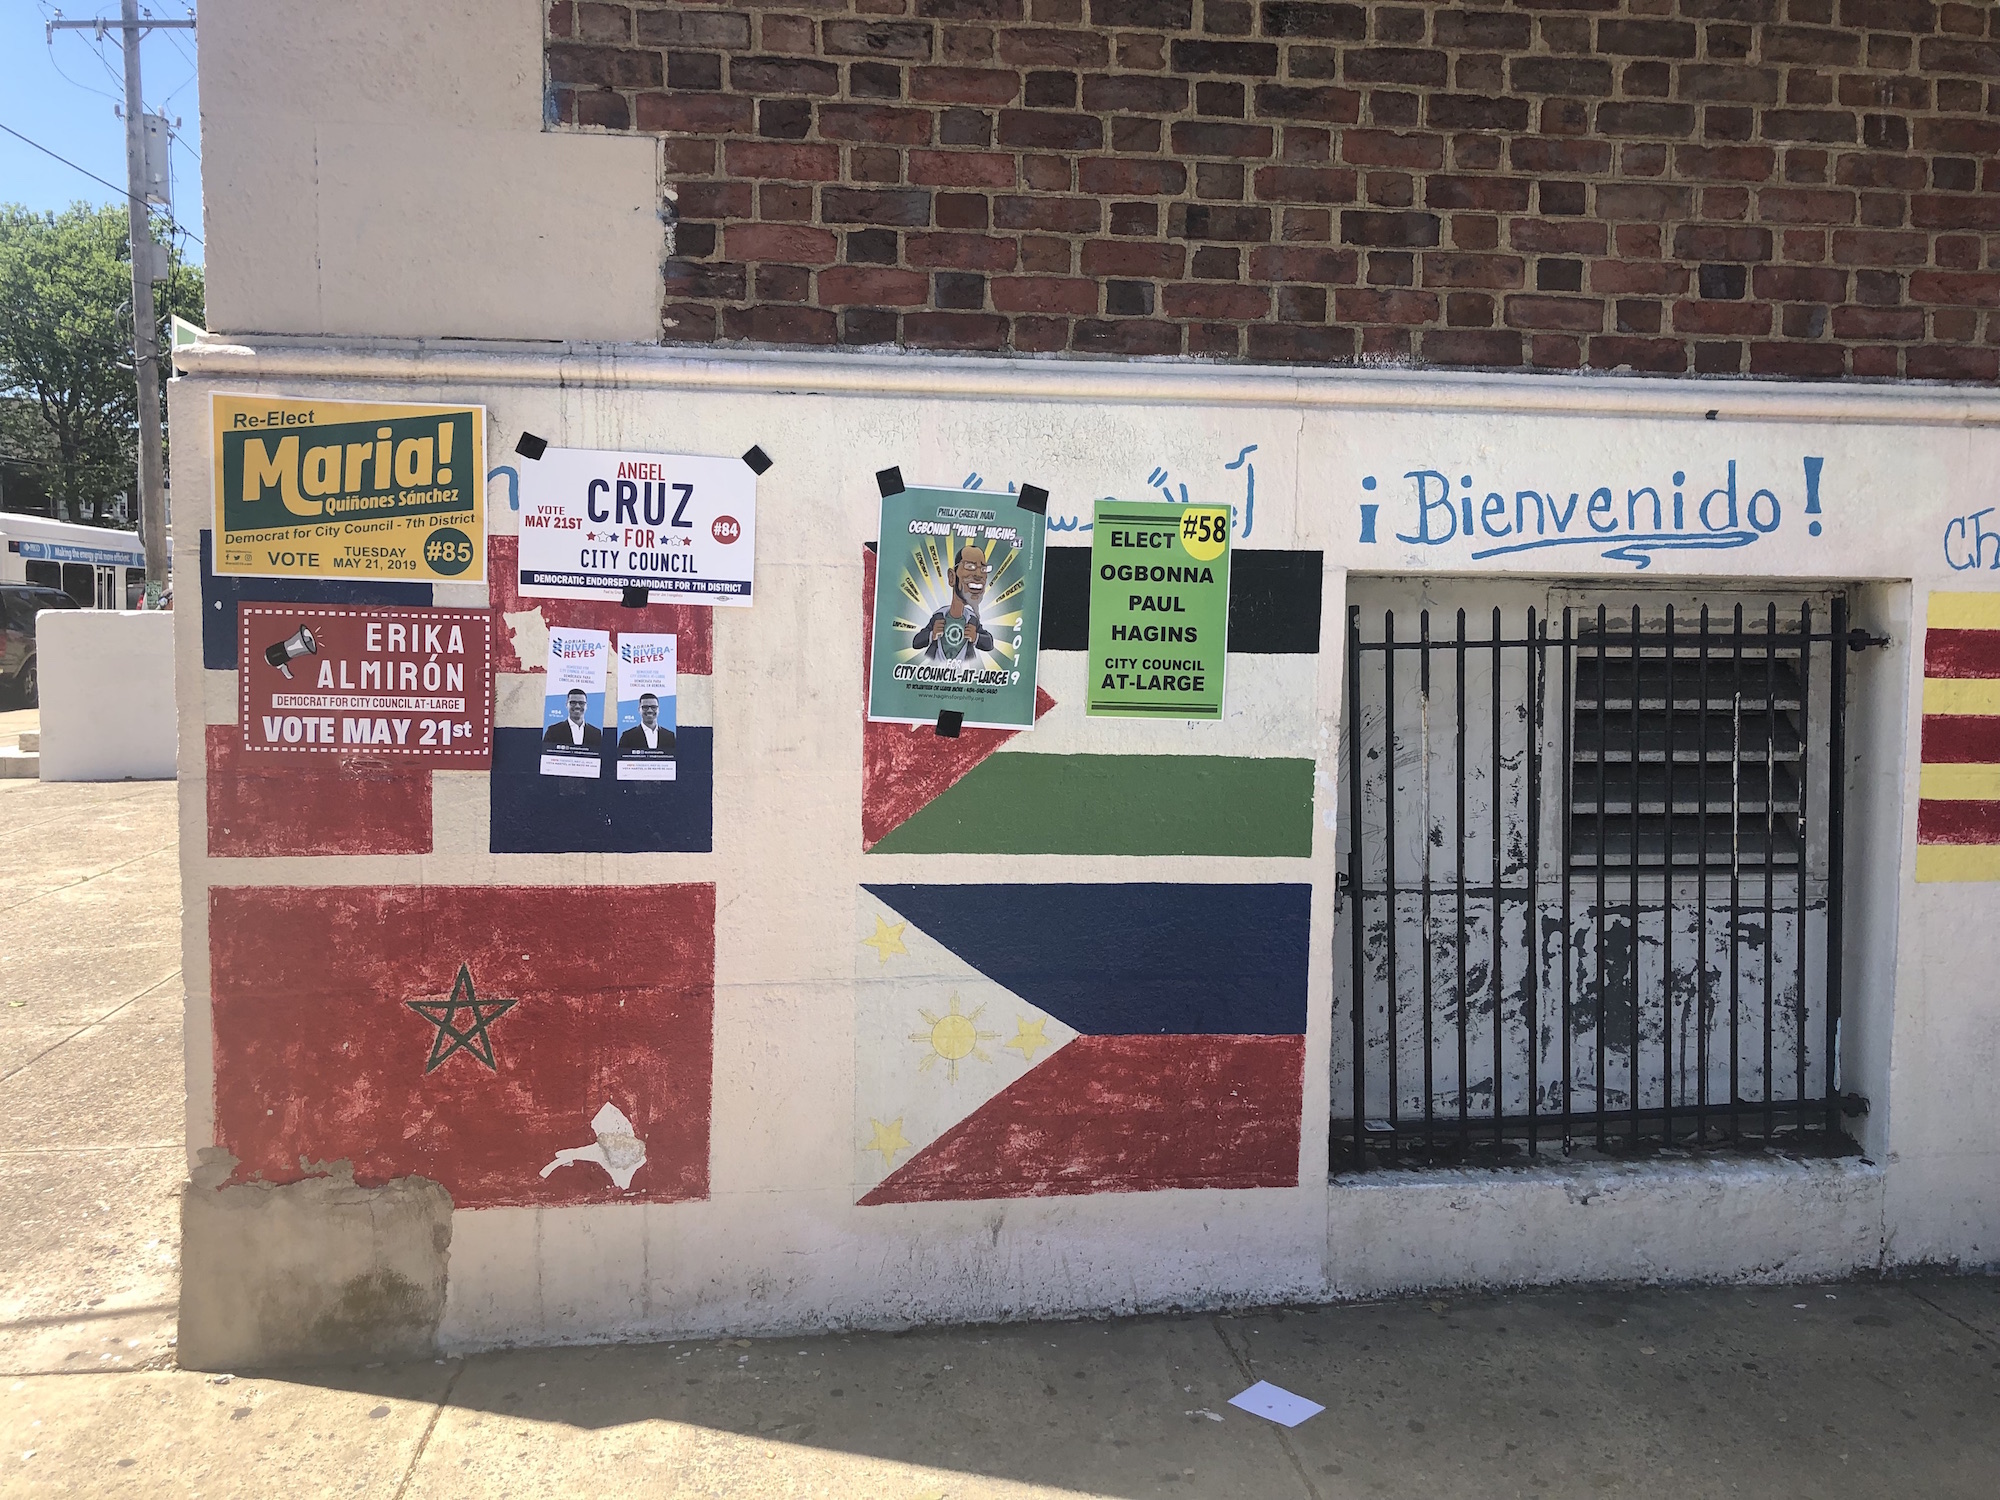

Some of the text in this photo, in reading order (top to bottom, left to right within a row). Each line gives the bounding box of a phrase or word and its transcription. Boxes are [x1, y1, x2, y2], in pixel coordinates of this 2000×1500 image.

[233, 409, 315, 428] Re-Elect
[242, 421, 455, 517] Maria!
[617, 461, 666, 481] ANGEL
[325, 488, 459, 516] Quiñones Sánchez
[537, 505, 565, 515] VOTE
[587, 478, 694, 528] CRUZ
[937, 507, 995, 520] PHILLY GREEN MAN
[225, 530, 290, 545] Democrat
[294, 527, 312, 540] for
[315, 523, 341, 540] City
[344, 520, 394, 536] Council
[405, 516, 425, 530] 7th
[429, 513, 475, 527] District
[525, 515, 583, 530] MAY 21ST
[713, 523, 738, 537] #84
[908, 520, 951, 536] OGBONNA
[985, 526, 1016, 540] HAGINS
[1183, 515, 1226, 543] #58
[624, 528, 656, 548] FOR
[1111, 531, 1175, 549] ELECT
[54, 547, 71, 560] Making
[72, 549, 80, 558] the
[267, 550, 320, 567] VOTE
[343, 546, 407, 559] TUESDAY
[426, 540, 472, 563] #85
[333, 558, 416, 571] MAY 21, 2019
[580, 549, 698, 574] CITY COUNCIL
[1100, 564, 1214, 584] OGBONNA
[533, 574, 742, 593] DEMOCRATIC ENDORSED CANDIDATE FOR 7TH DISTRICT
[1129, 595, 1185, 612] PAUL
[366, 622, 465, 654] ERIKA
[1111, 625, 1198, 642] HAGINS
[564, 642, 606, 651] RIVERA-
[564, 650, 595, 658] REYES
[633, 646, 674, 657] RIVERA-
[634, 654, 664, 664] REYES
[947, 658, 962, 669] FOR
[1105, 658, 1205, 671] CITY COUNCIL
[317, 654, 464, 692] ALMIRÓN
[894, 665, 916, 680] CITY
[1101, 674, 1205, 692] AT-LARGE
[277, 696, 460, 710] DEMOCRAT FOR CITY COUNCIL AT-LARGE
[262, 716, 472, 746] VOTE MAY 21st
